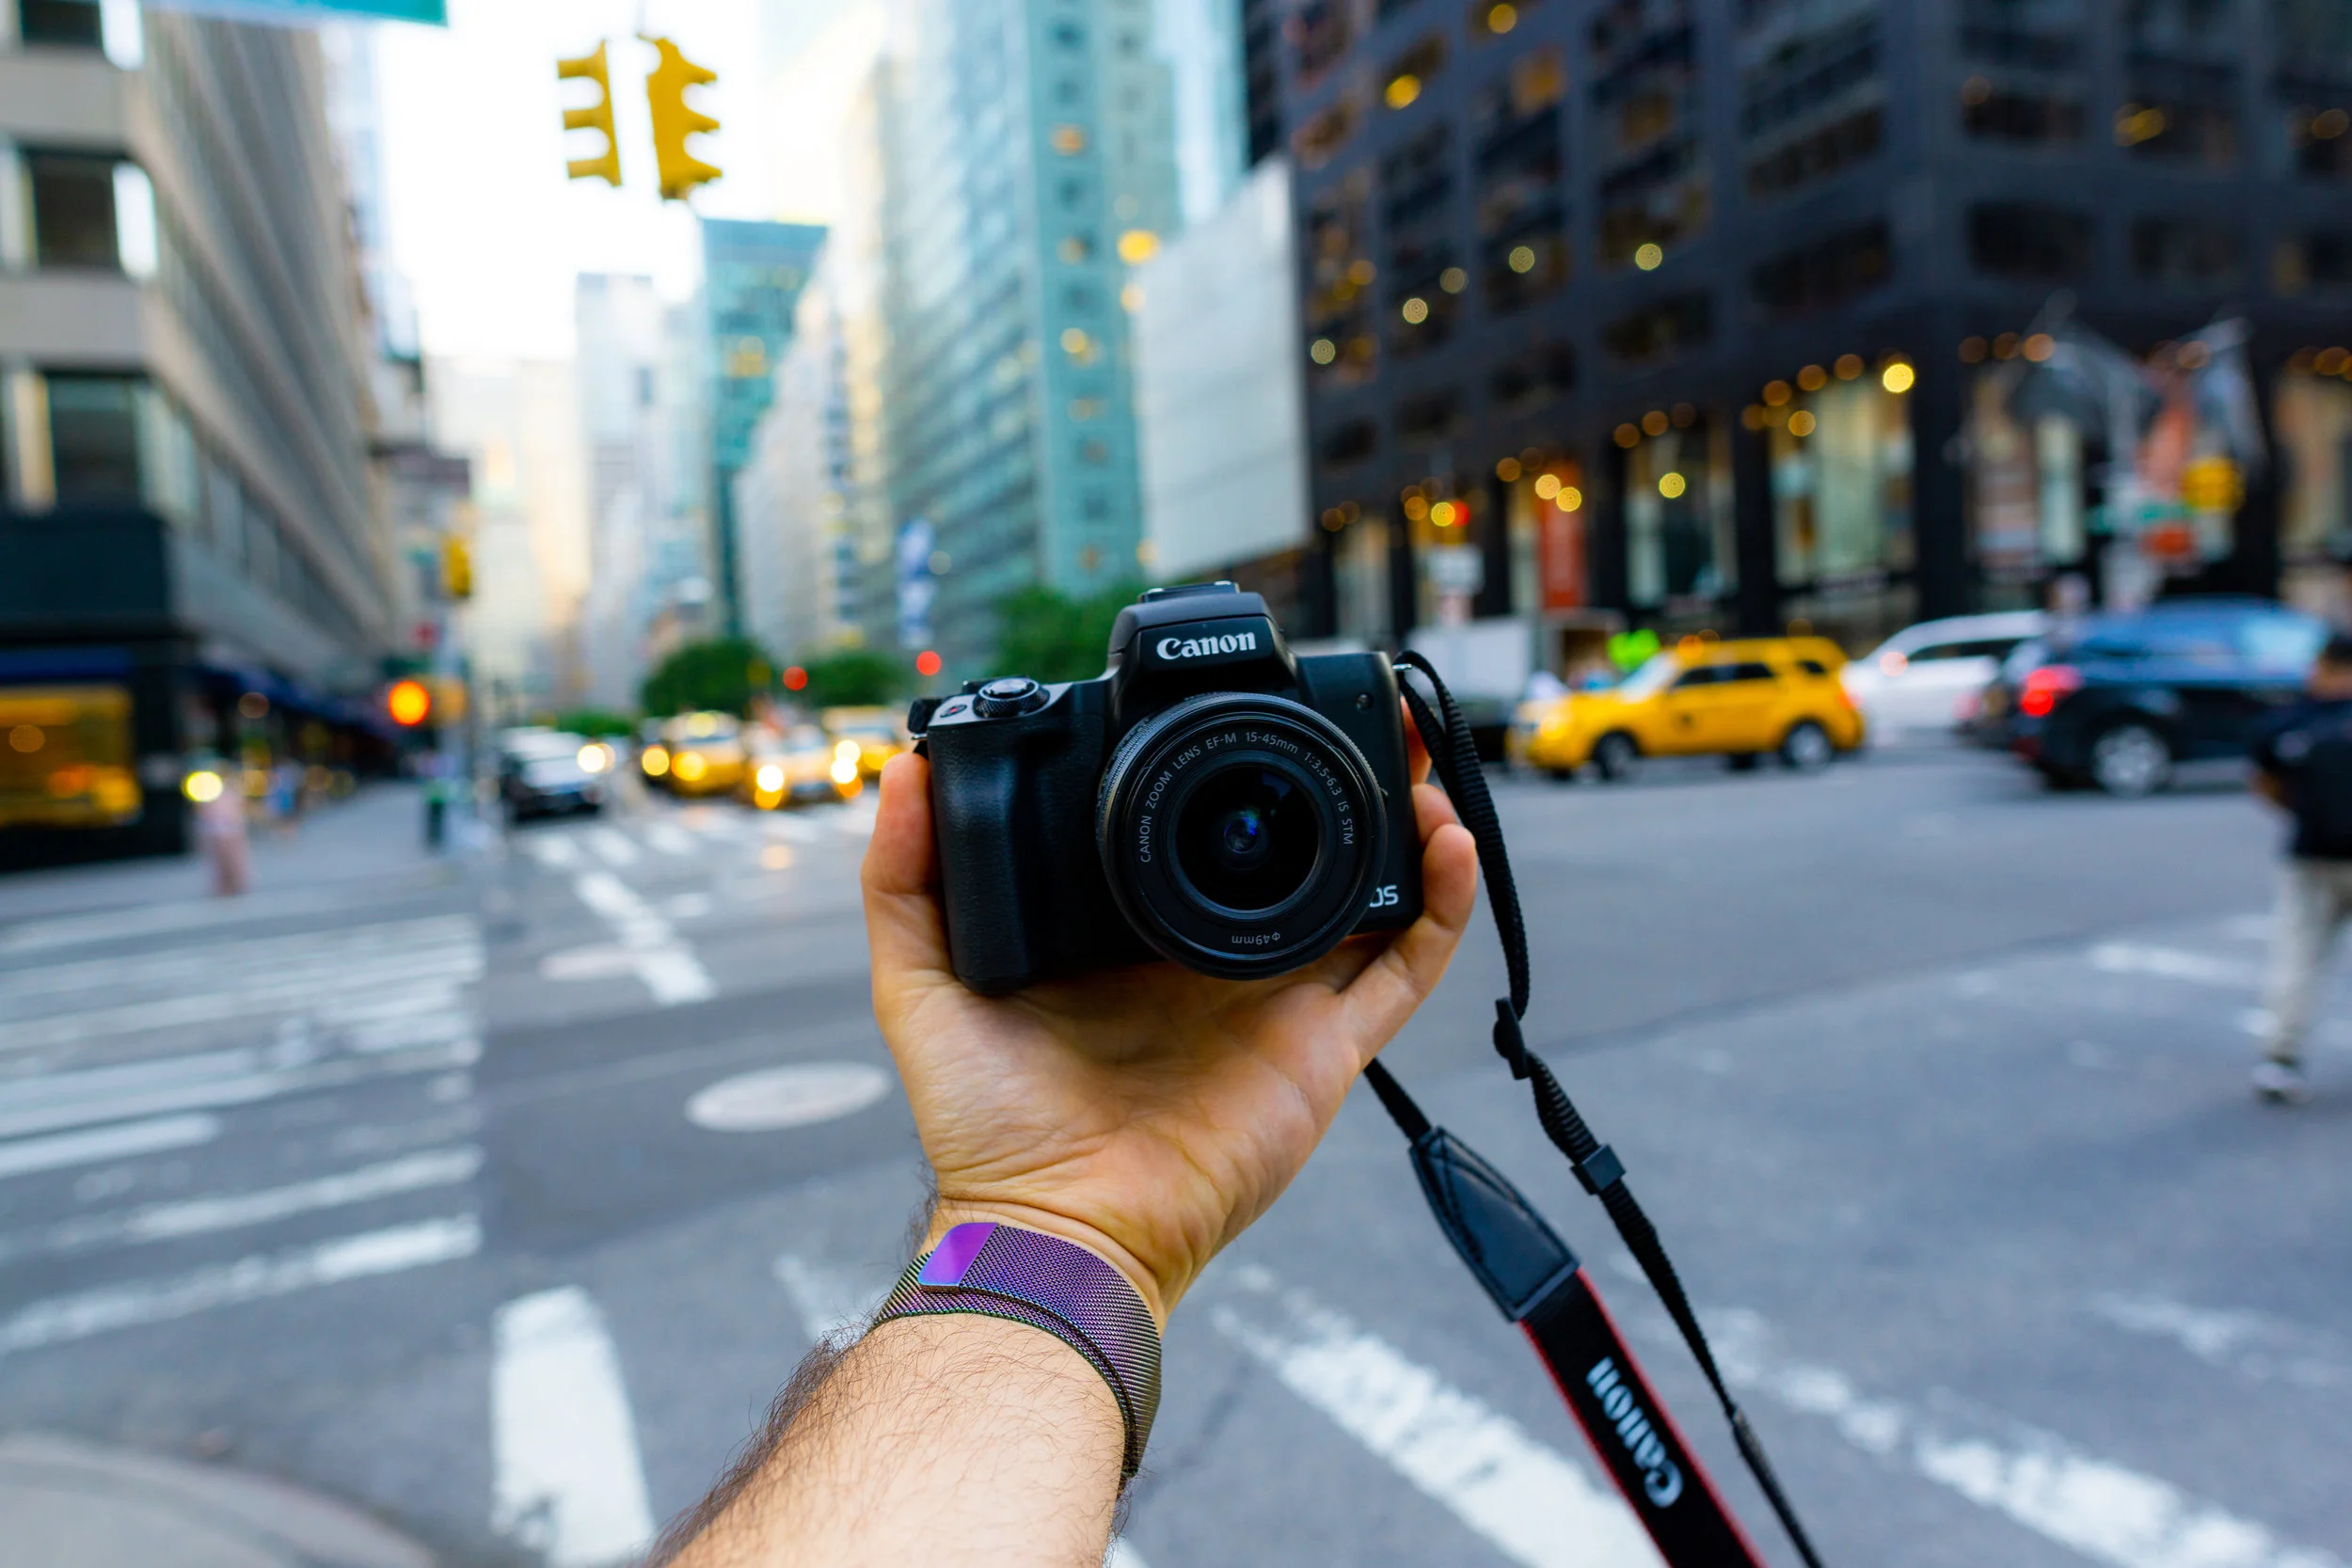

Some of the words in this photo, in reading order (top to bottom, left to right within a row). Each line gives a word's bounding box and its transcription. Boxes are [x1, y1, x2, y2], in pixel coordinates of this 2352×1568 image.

[1156, 631, 1257, 660] Canon
[1205, 732, 1237, 750] EF-M
[1245, 731, 1298, 753] 15-45mm
[1172, 745, 1201, 769] LENS
[1303, 752, 1343, 796] 1:3.5-6.3
[1145, 770, 1173, 809] ZOOM
[1337, 800, 1350, 813] IS
[1138, 815, 1152, 863] CANON
[1342, 817, 1354, 845] STM
[1585, 1355, 1684, 1507] Canon
